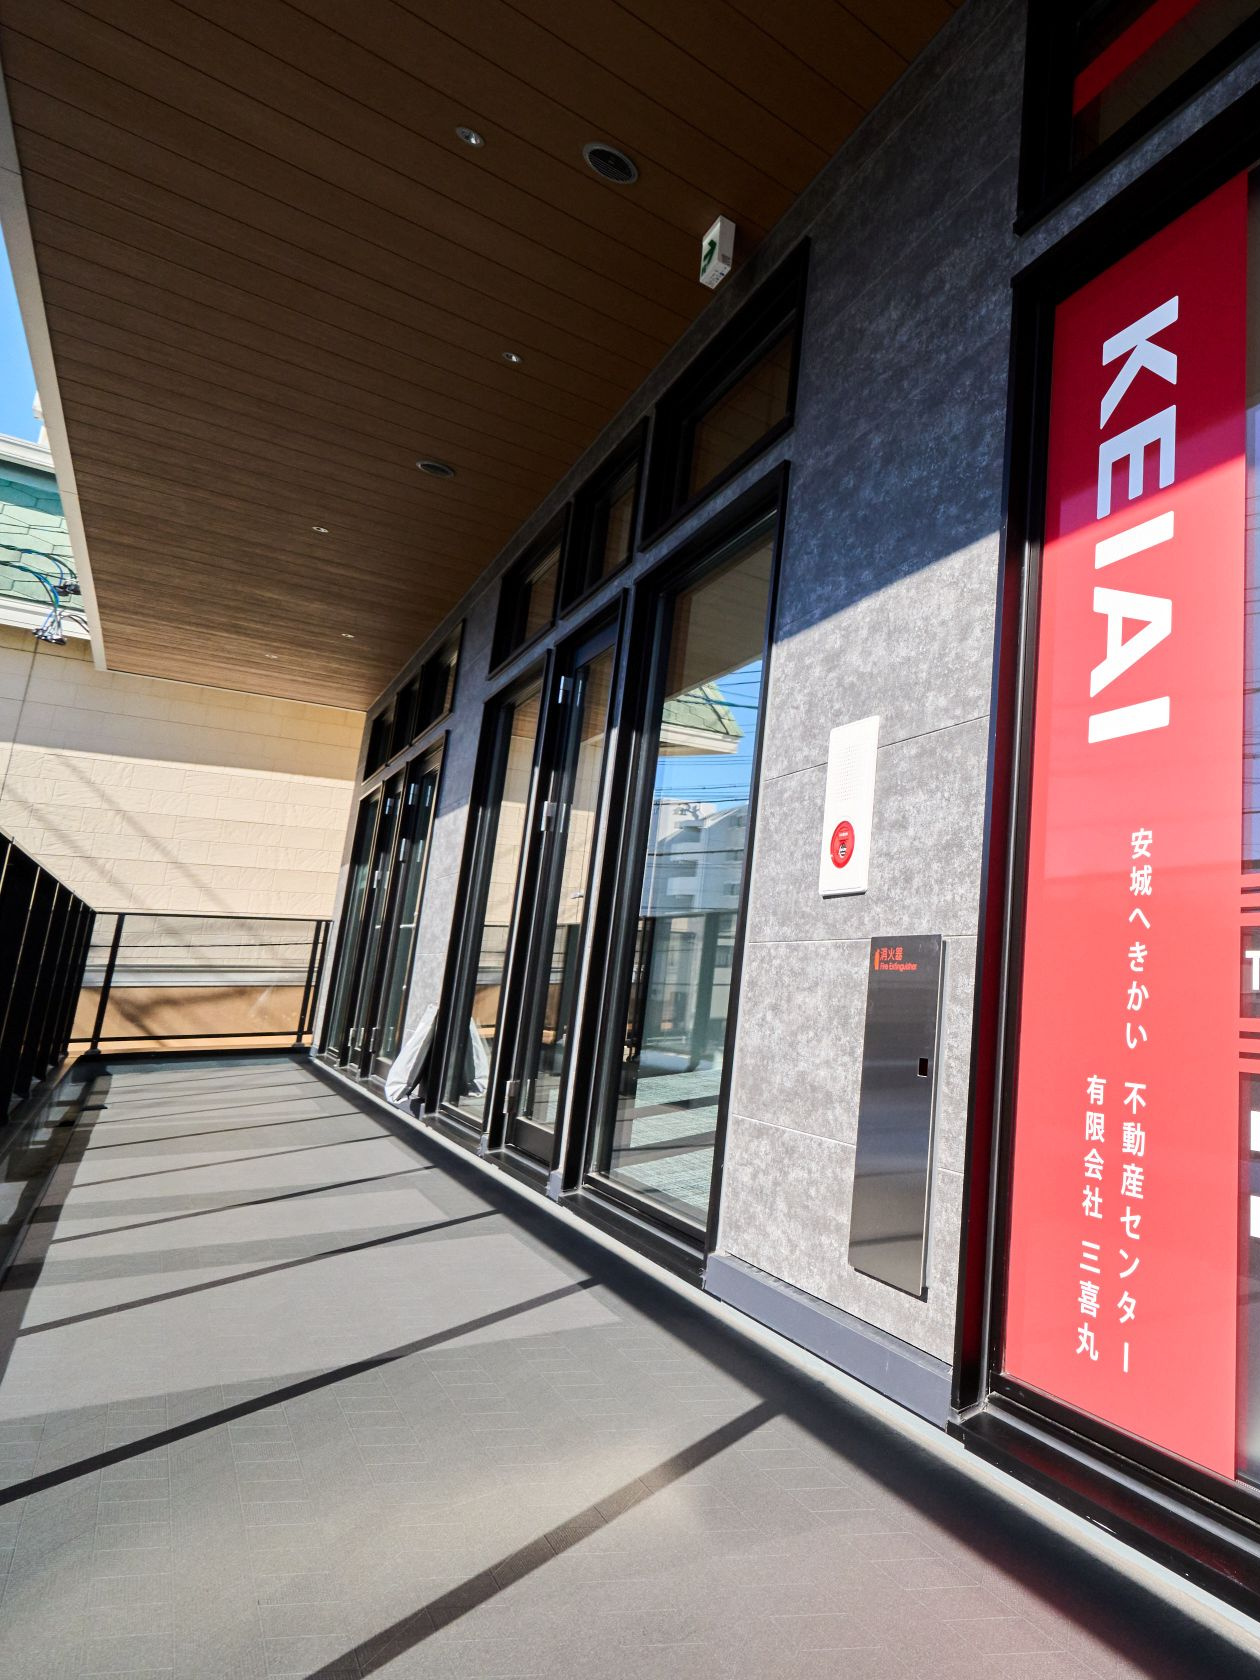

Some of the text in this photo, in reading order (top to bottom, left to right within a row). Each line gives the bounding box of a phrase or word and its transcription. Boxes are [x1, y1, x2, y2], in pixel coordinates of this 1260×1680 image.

[1088, 295, 1179, 744] KEIAI
[880, 946, 903, 961] 消火器
[1116, 828, 1154, 1373] 安城へきかい 不動産センター
[1076, 1075, 1107, 1361] 有限会社 三喜丸
